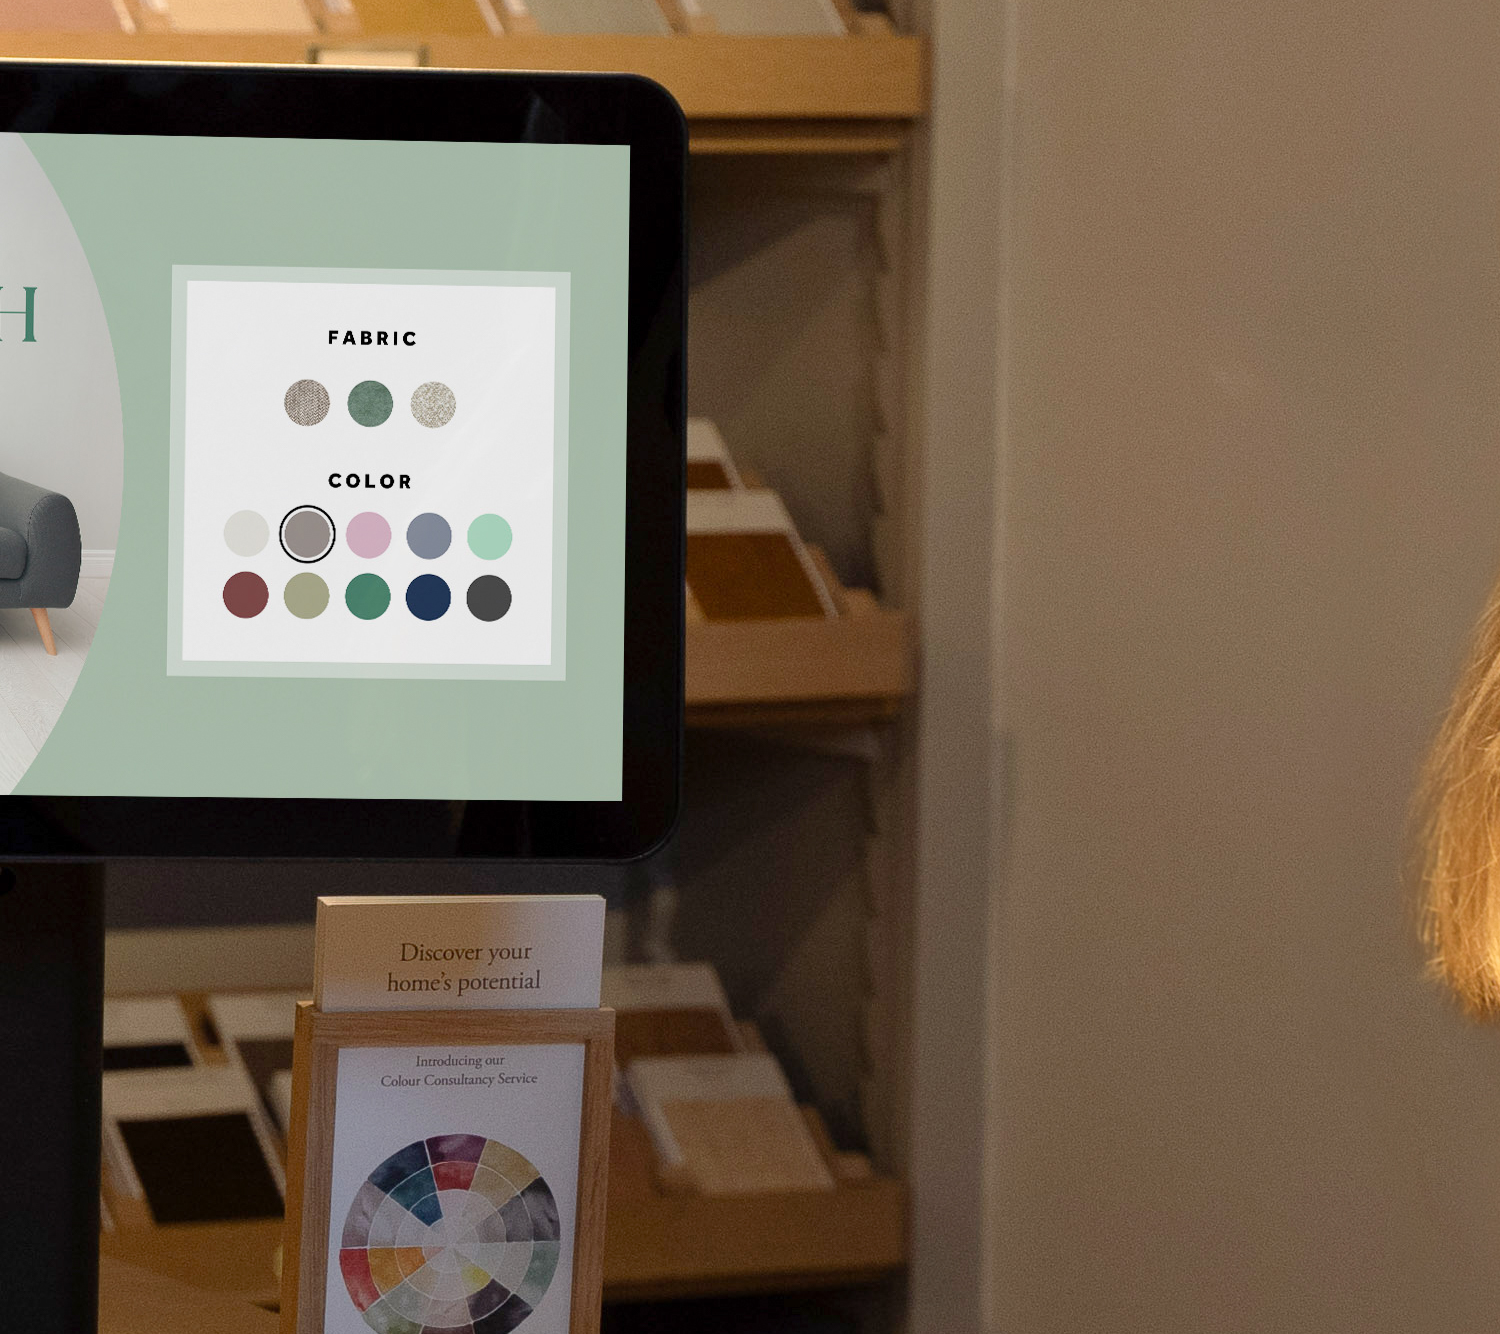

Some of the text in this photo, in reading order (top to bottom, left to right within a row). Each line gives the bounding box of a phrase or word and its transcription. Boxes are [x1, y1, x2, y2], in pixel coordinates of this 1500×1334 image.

[328, 329, 417, 347] FABRIC
[327, 472, 412, 490] COLOR
[399, 942, 533, 967] Discover your
[386, 969, 541, 998] home's potential
[415, 1054, 506, 1070] Introducing our
[380, 1072, 539, 1089] Colour Consultancy Service
